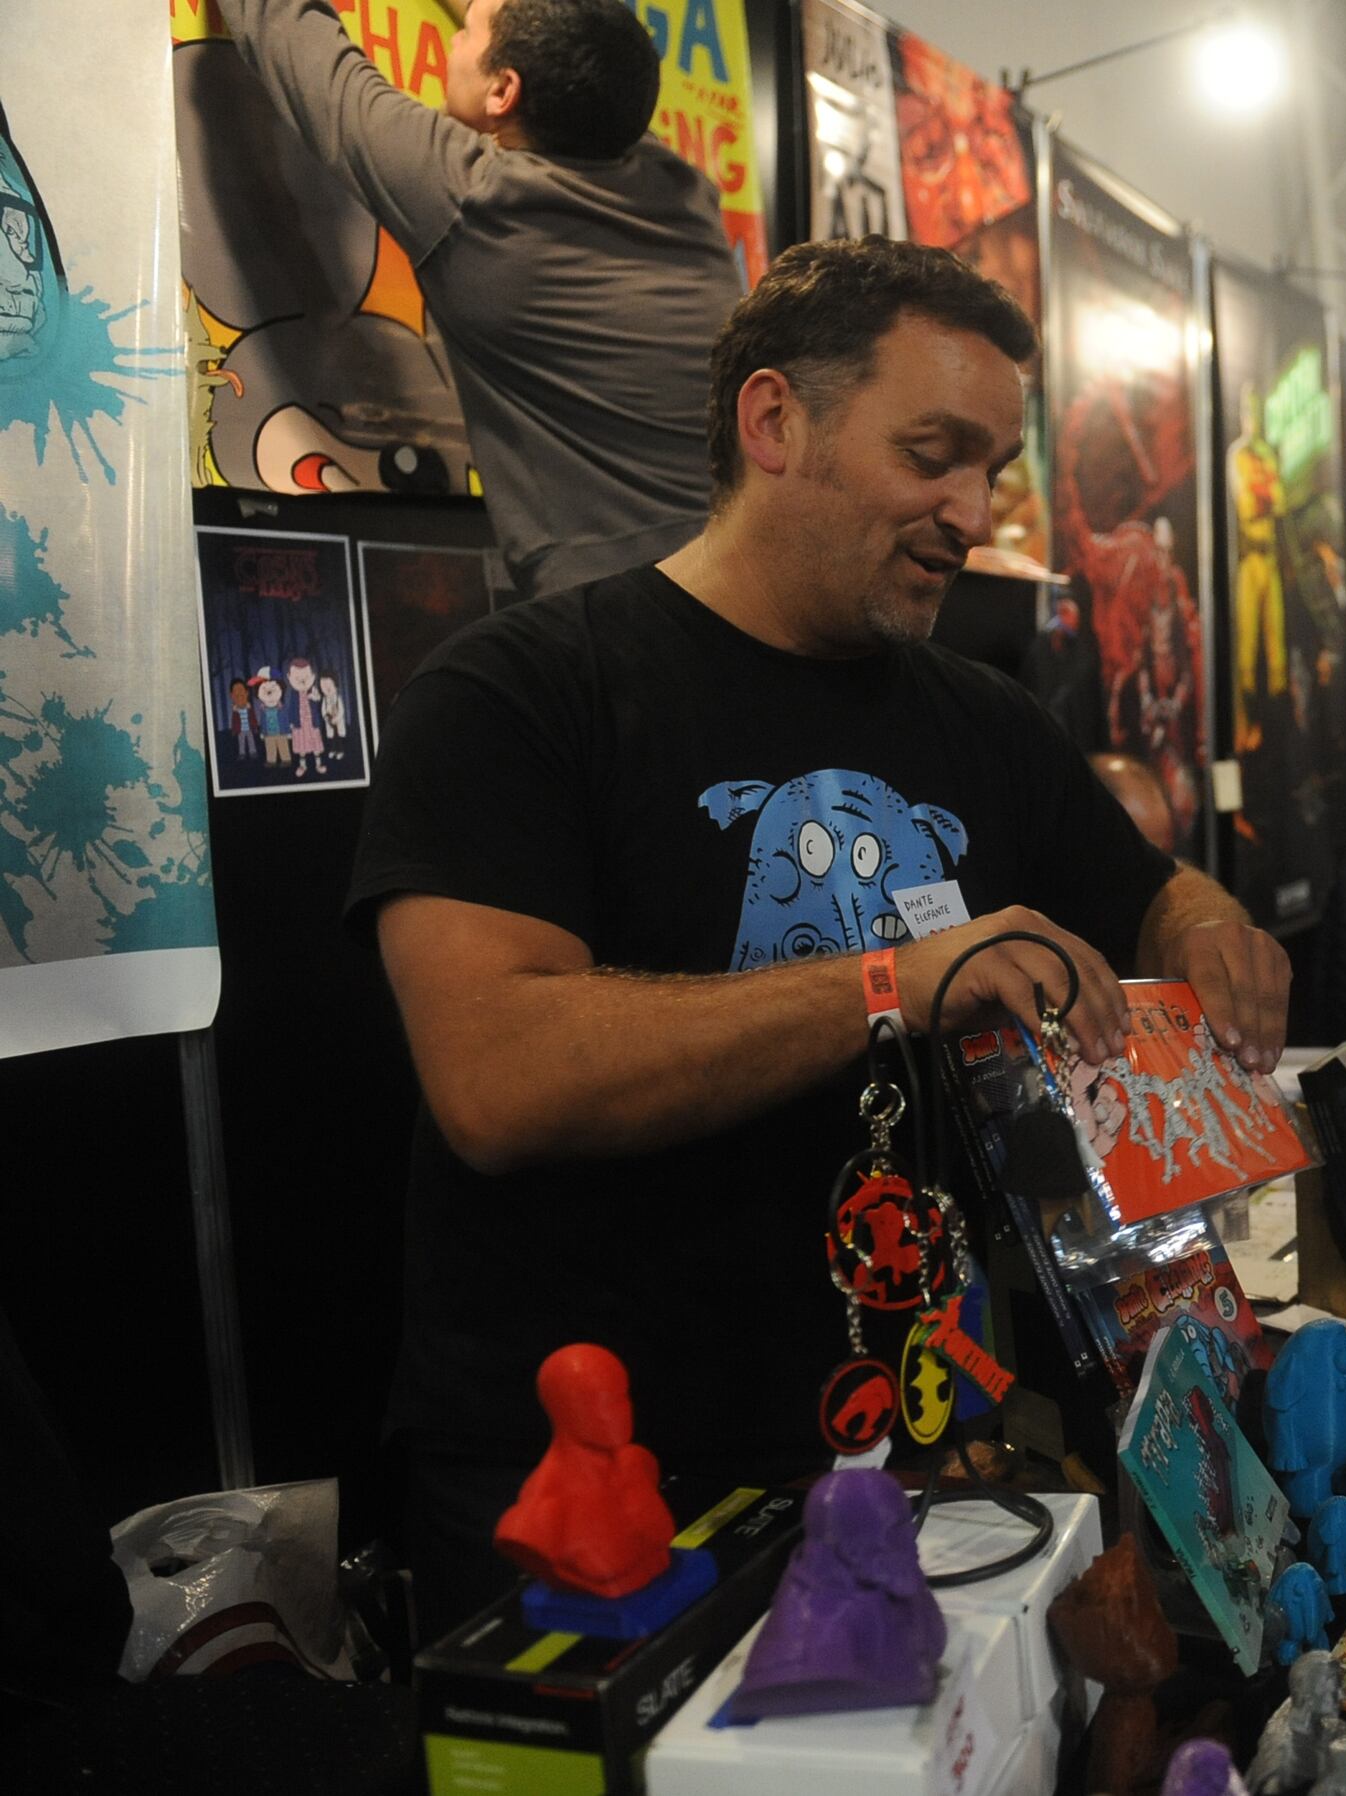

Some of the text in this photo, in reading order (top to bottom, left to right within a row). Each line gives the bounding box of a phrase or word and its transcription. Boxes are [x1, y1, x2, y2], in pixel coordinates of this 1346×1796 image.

[904, 894, 933, 912] DANTE
[914, 904, 951, 924] ELEFANTE
[1219, 1290, 1234, 1317] 5
[1182, 1325, 1197, 1343] 10
[734, 1496, 794, 1538] SLATE
[635, 1655, 697, 1727] SLATE
